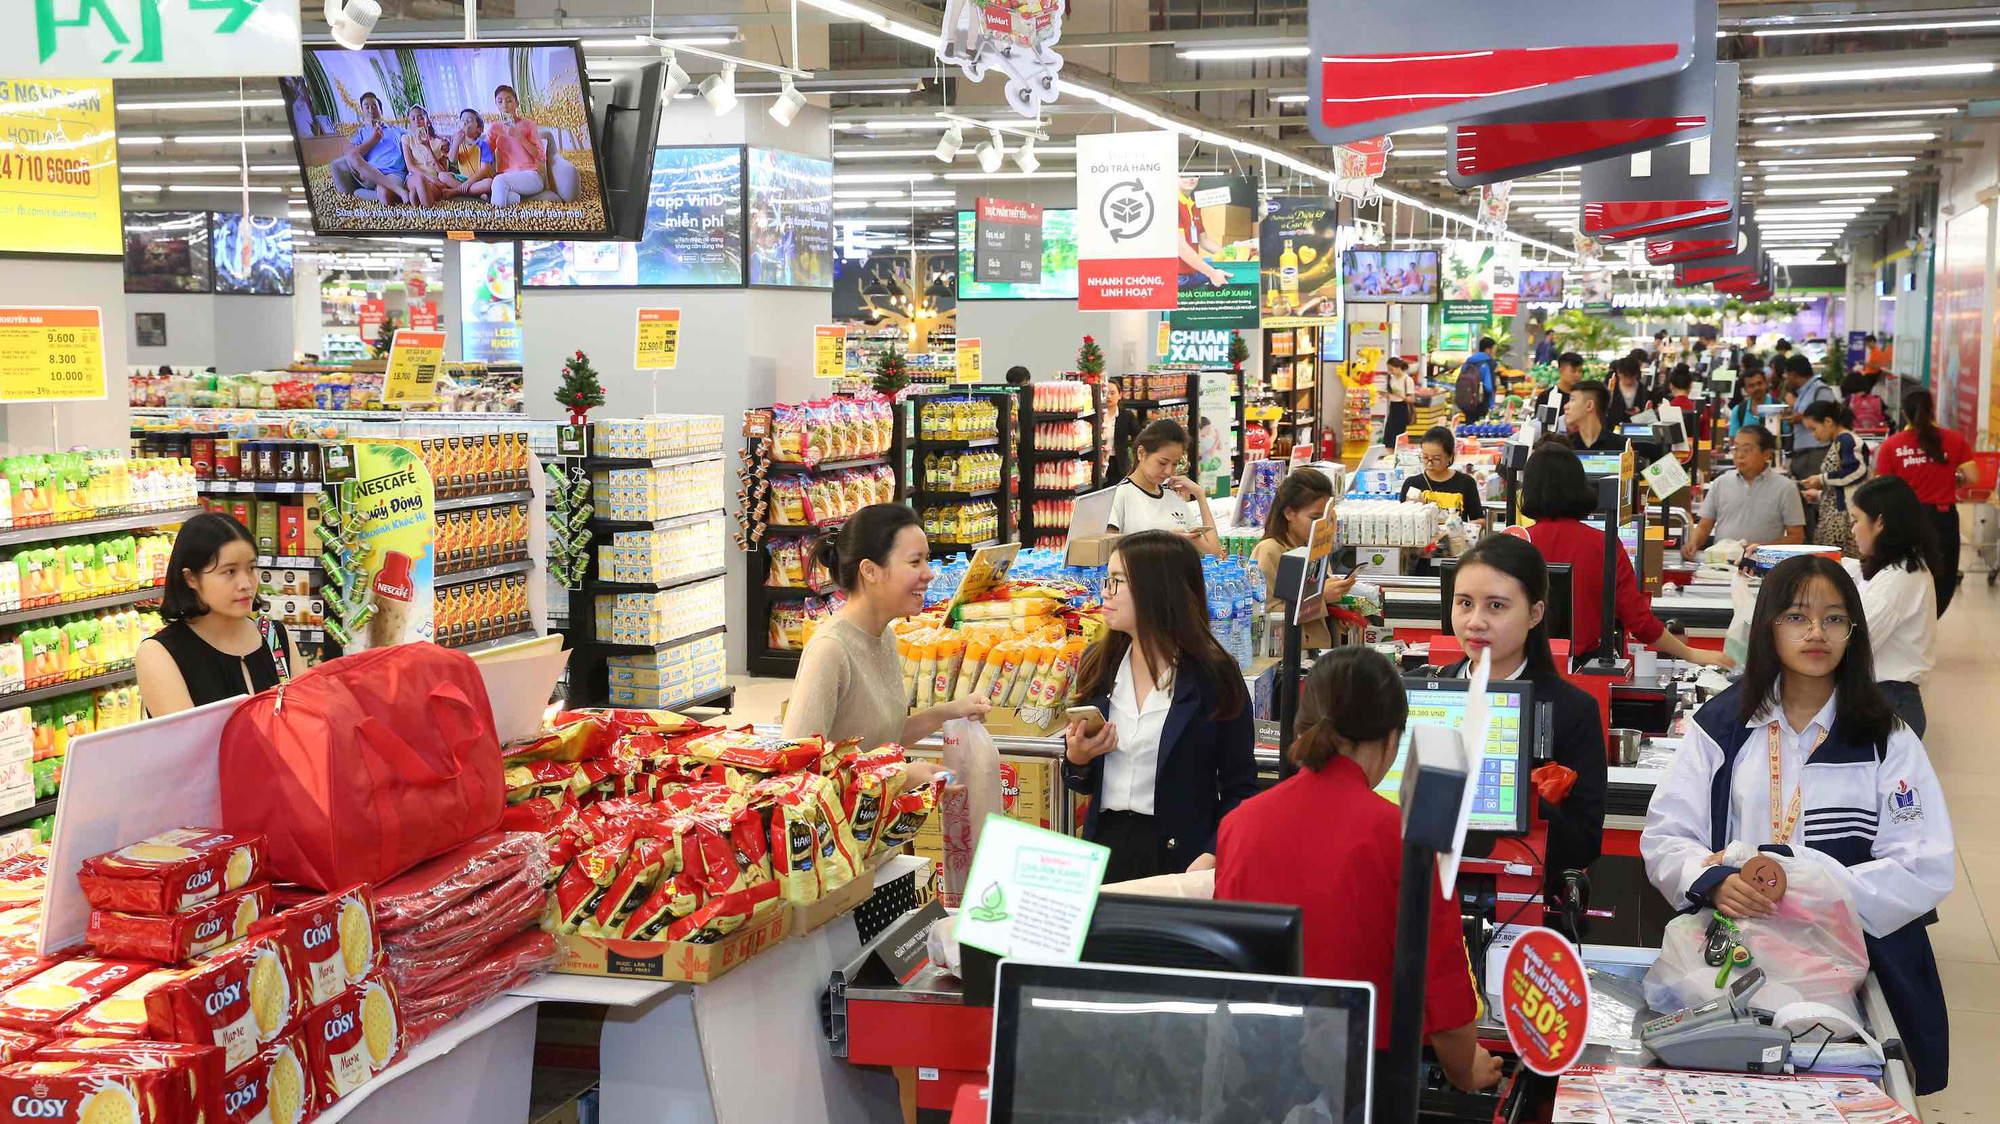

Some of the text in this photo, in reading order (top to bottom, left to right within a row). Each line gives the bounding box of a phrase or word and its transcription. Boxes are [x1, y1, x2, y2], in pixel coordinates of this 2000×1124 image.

[987, 14, 1009, 26] VinMart
[15, 153, 44, 182] 710
[1132, 163, 1161, 173] HÀNG
[656, 194, 724, 209] app VinID
[665, 212, 724, 229] miễn phí
[1087, 274, 1164, 287] NHANH CHÓNG,
[1101, 287, 1154, 299] LINH HOẠT
[1194, 290, 1215, 298] CUNG
[1216, 287, 1231, 298] CẤP
[1231, 289, 1252, 297] XANH
[47, 333, 75, 342] 9.600
[495, 328, 515, 338] LESS
[491, 338, 520, 348] RIGHT
[49, 354, 76, 364] 8.300
[1170, 345, 1230, 362] XANH
[51, 371, 83, 381] 10.000
[357, 464, 417, 499] NESCAFÉ
[377, 583, 409, 598] NESCAFÉ
[1490, 762, 1496, 770] 9
[1490, 775, 1495, 783] 6
[186, 868, 214, 891] COSY
[195, 917, 223, 940] COSY
[302, 922, 333, 949] COSY
[1523, 943, 1544, 969] DÙNG
[1523, 958, 1550, 993] VinID
[1547, 989, 1566, 1010] Pay
[205, 980, 242, 1017] COSY
[1521, 984, 1570, 1040] 50%
[222, 1024, 245, 1045] Marie
[324, 1011, 355, 1042] COSY
[340, 1052, 360, 1071] Marie
[224, 1077, 261, 1117] COSY
[10, 1096, 69, 1118] COSY
